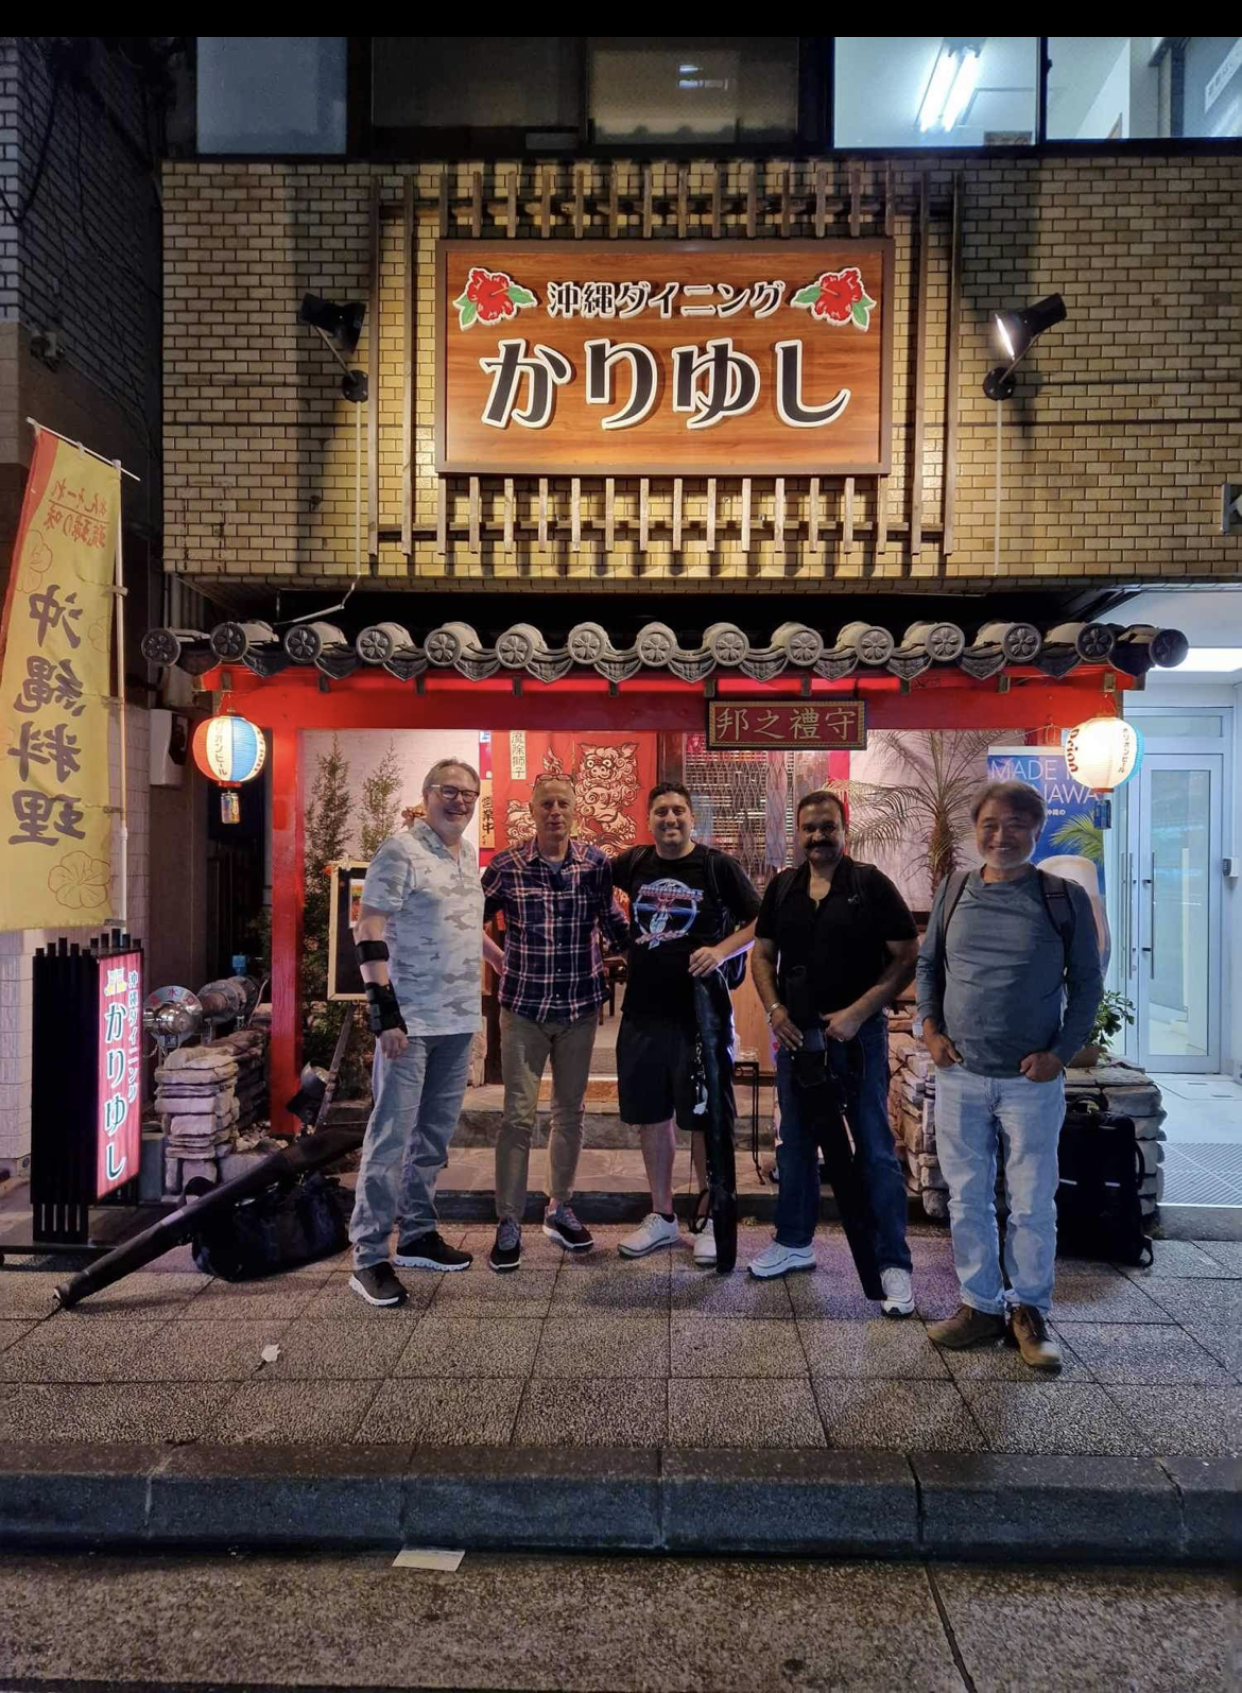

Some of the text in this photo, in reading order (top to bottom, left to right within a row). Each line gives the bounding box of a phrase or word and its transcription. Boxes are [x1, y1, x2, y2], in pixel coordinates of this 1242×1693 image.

[547, 281, 786, 319] 沖縄ダイニング
[479, 337, 852, 430] かりゆし
[991, 759, 1057, 781] MADE
[103, 1002, 127, 1181] かりゆし
